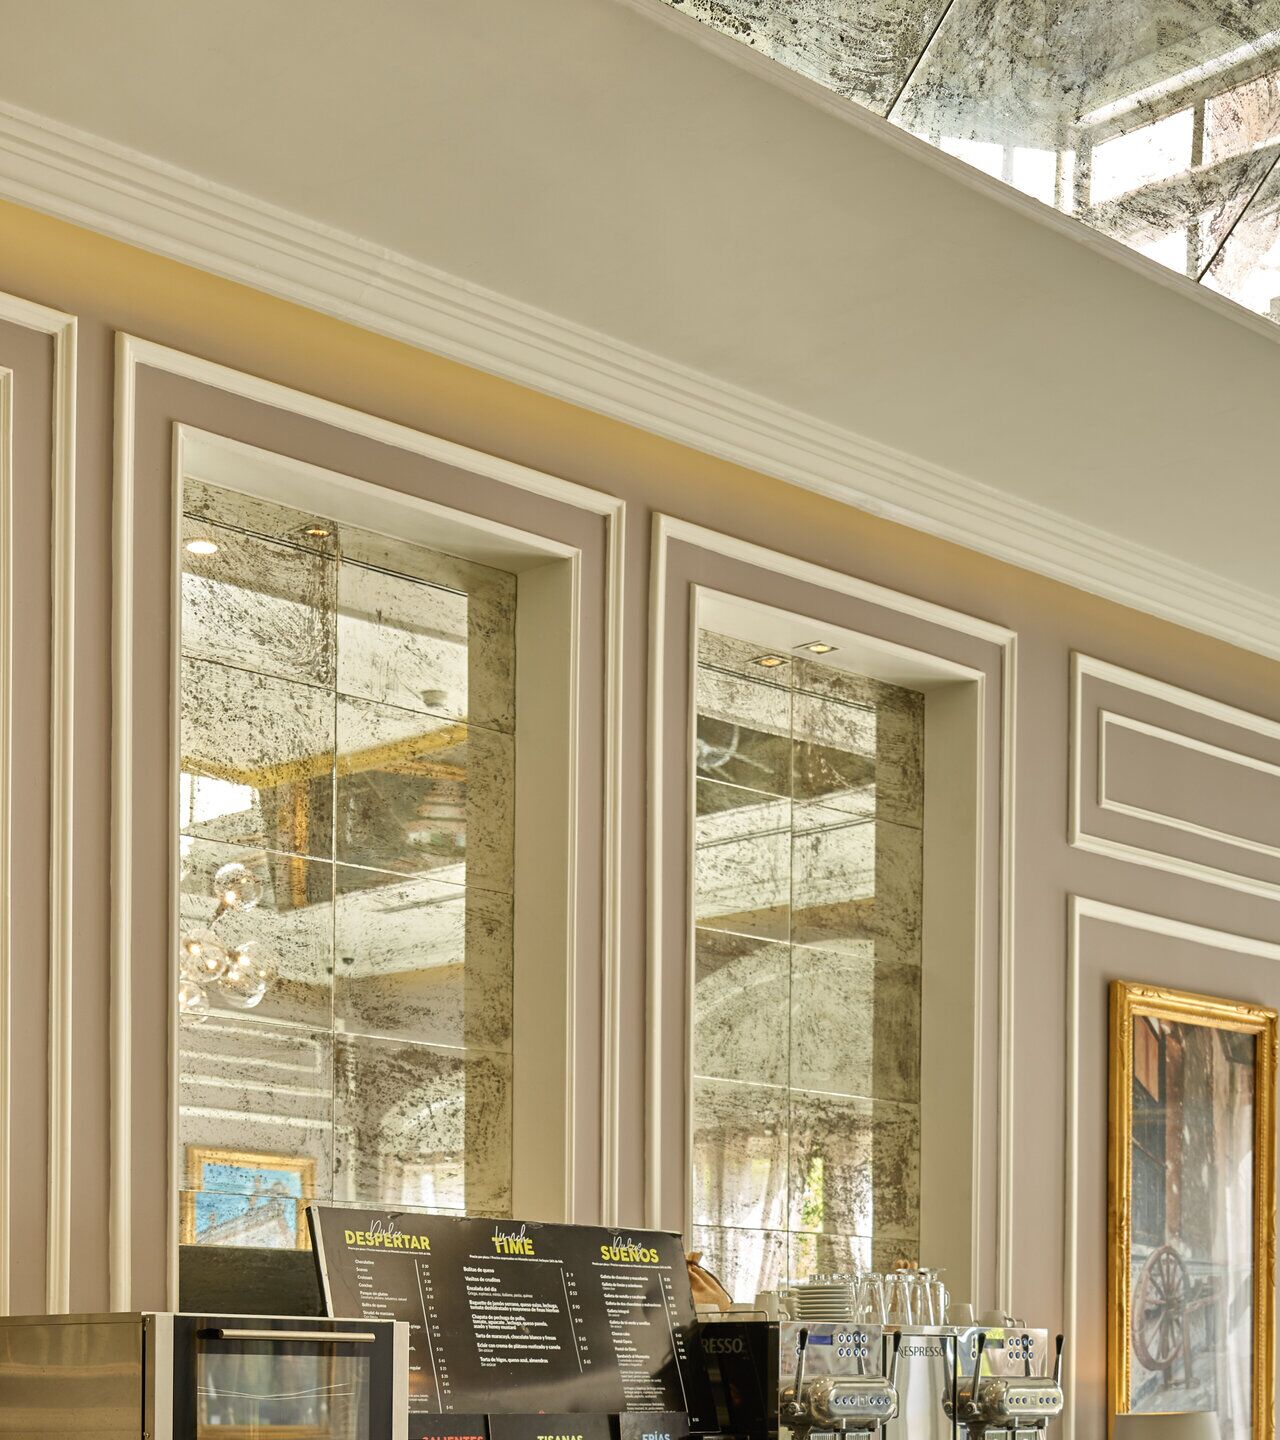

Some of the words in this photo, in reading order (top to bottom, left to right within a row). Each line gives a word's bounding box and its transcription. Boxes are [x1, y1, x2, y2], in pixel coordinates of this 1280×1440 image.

[344, 1230, 431, 1250] DESPERTAR
[494, 1223, 529, 1246] Lunch
[491, 1236, 535, 1255] TIME
